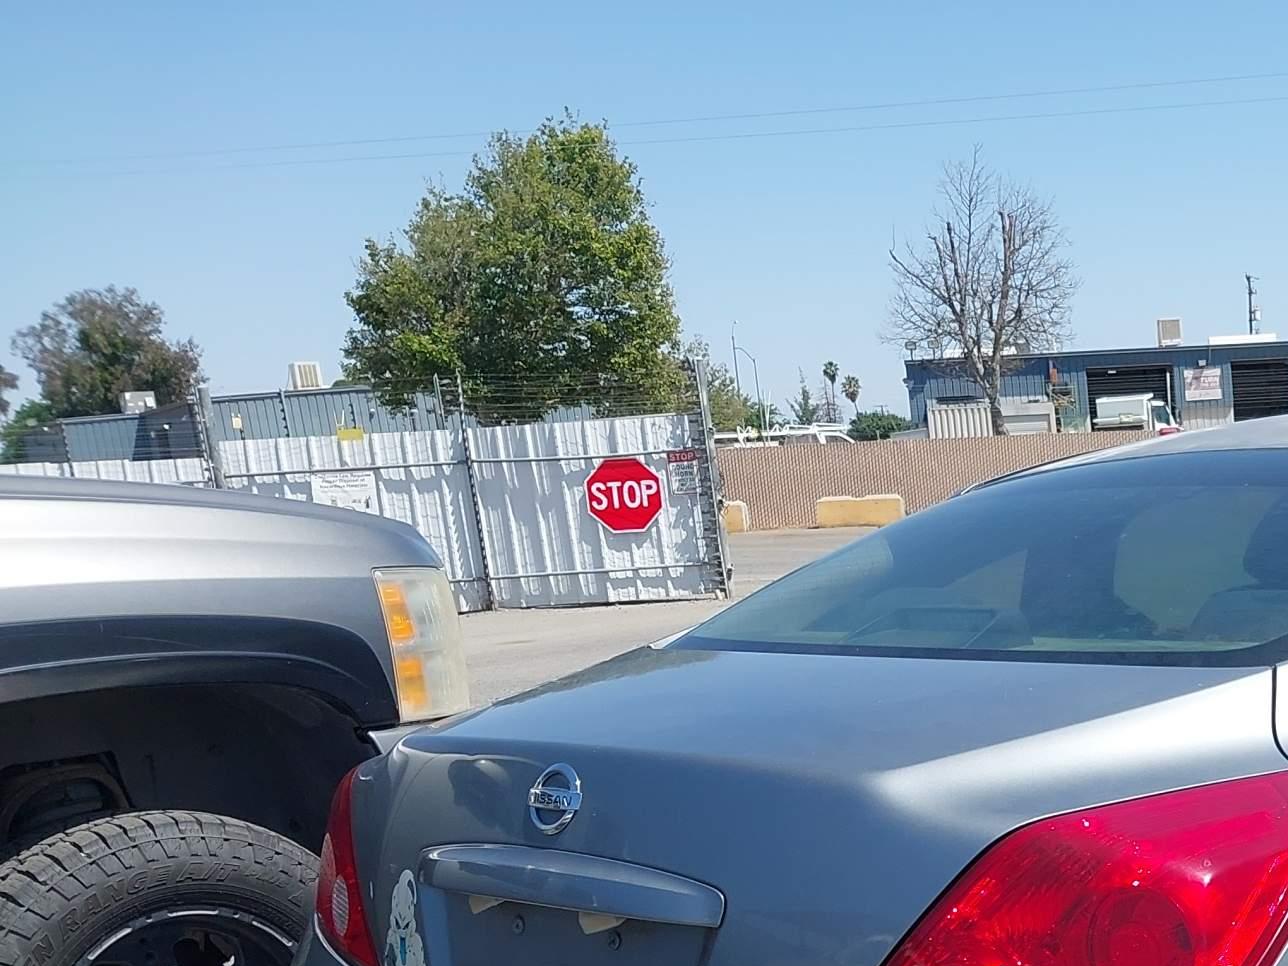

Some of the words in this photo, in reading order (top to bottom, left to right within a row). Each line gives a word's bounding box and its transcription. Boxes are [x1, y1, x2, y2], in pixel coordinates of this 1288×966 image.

[669, 452, 694, 462] STOP
[591, 480, 658, 511] STOP
[529, 790, 573, 807] NISSAN
[56, 864, 175, 942] RANGE
[175, 862, 241, 882] A/T
